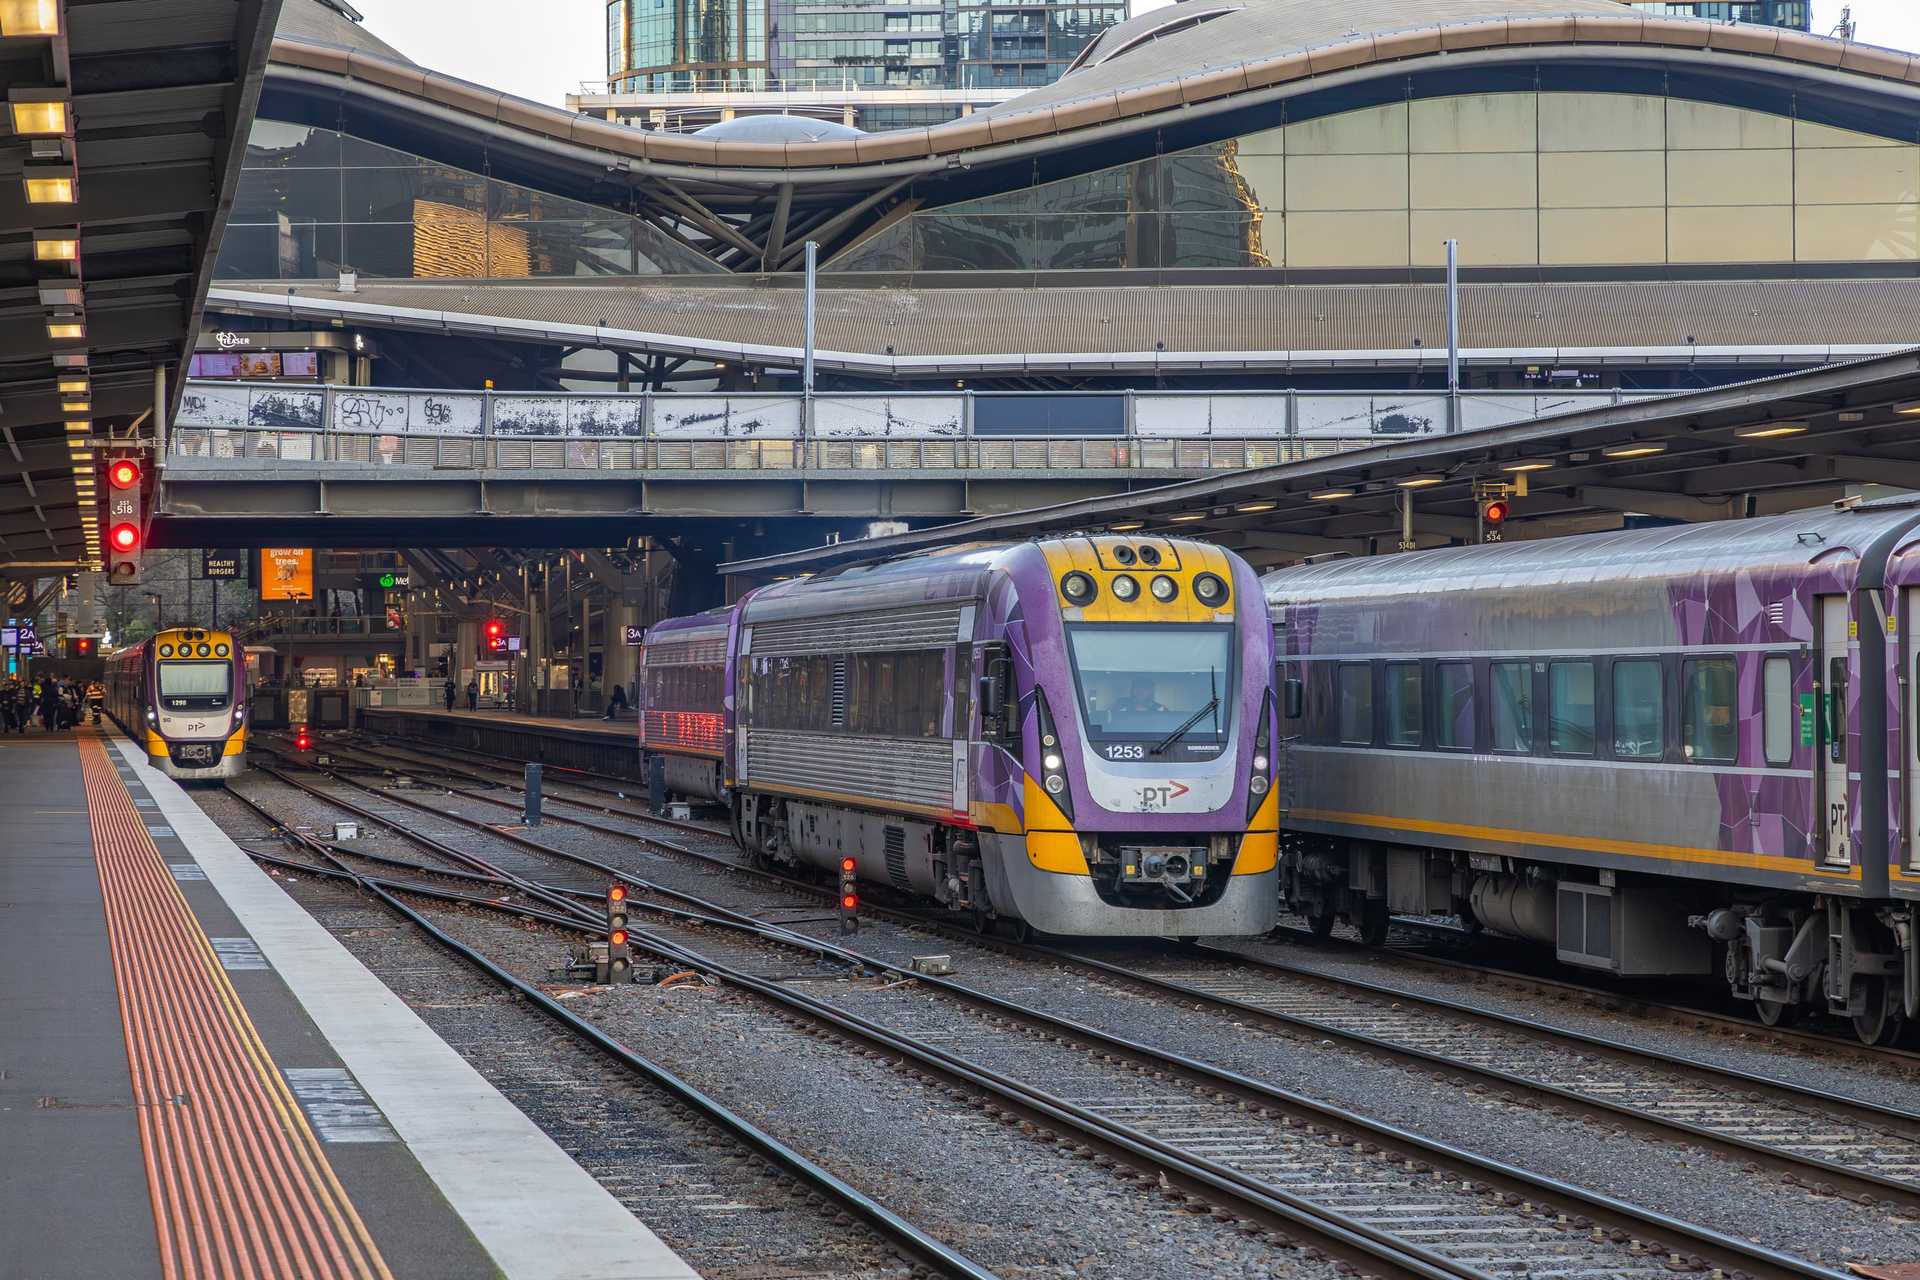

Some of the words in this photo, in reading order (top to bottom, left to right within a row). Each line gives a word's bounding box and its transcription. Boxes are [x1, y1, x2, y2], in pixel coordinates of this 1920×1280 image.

[116, 505, 133, 514] 518
[20, 628, 35, 639] 2A
[627, 628, 641, 639] 3A
[1105, 745, 1144, 759] 1253
